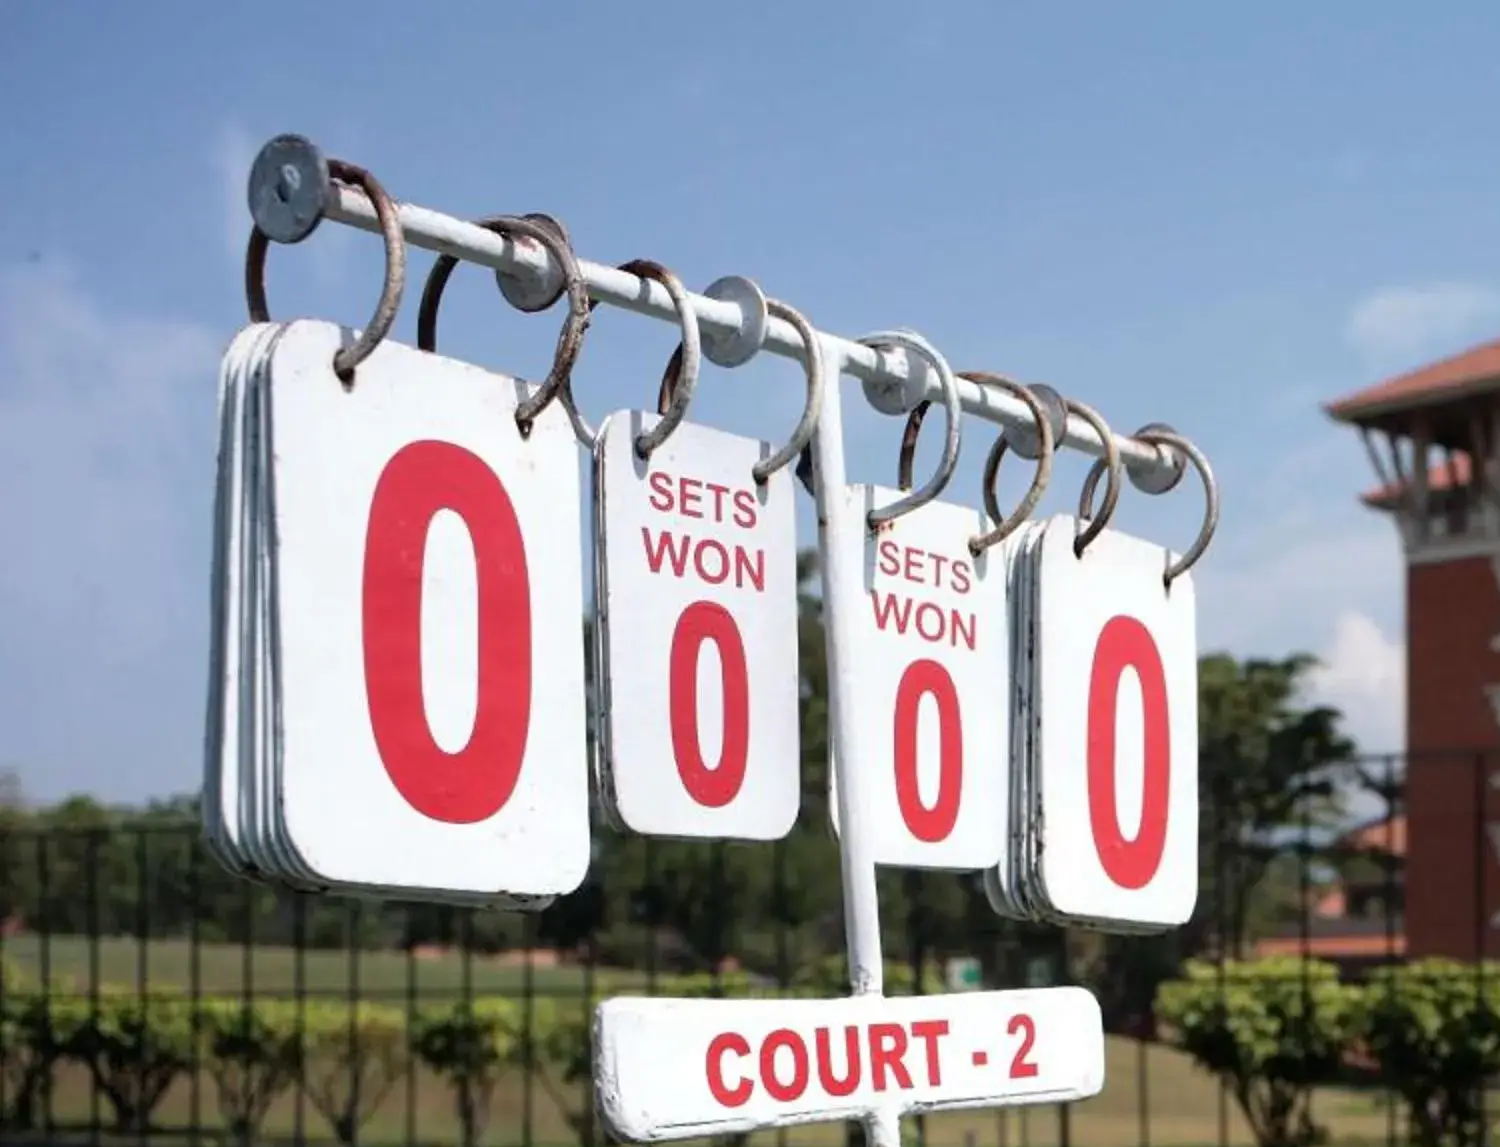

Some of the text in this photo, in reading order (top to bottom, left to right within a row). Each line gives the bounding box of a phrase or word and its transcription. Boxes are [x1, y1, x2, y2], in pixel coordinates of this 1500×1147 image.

[648, 471, 757, 529] SETS
[641, 526, 766, 593] WON
[878, 539, 972, 595] SETS
[362, 440, 531, 824] 0
[870, 588, 977, 651] WON
[668, 599, 750, 809] 0
[893, 658, 963, 843] 0
[1087, 615, 1171, 890] 0
[705, 1019, 950, 1109] COURT
[1006, 1012, 1039, 1080] 2
